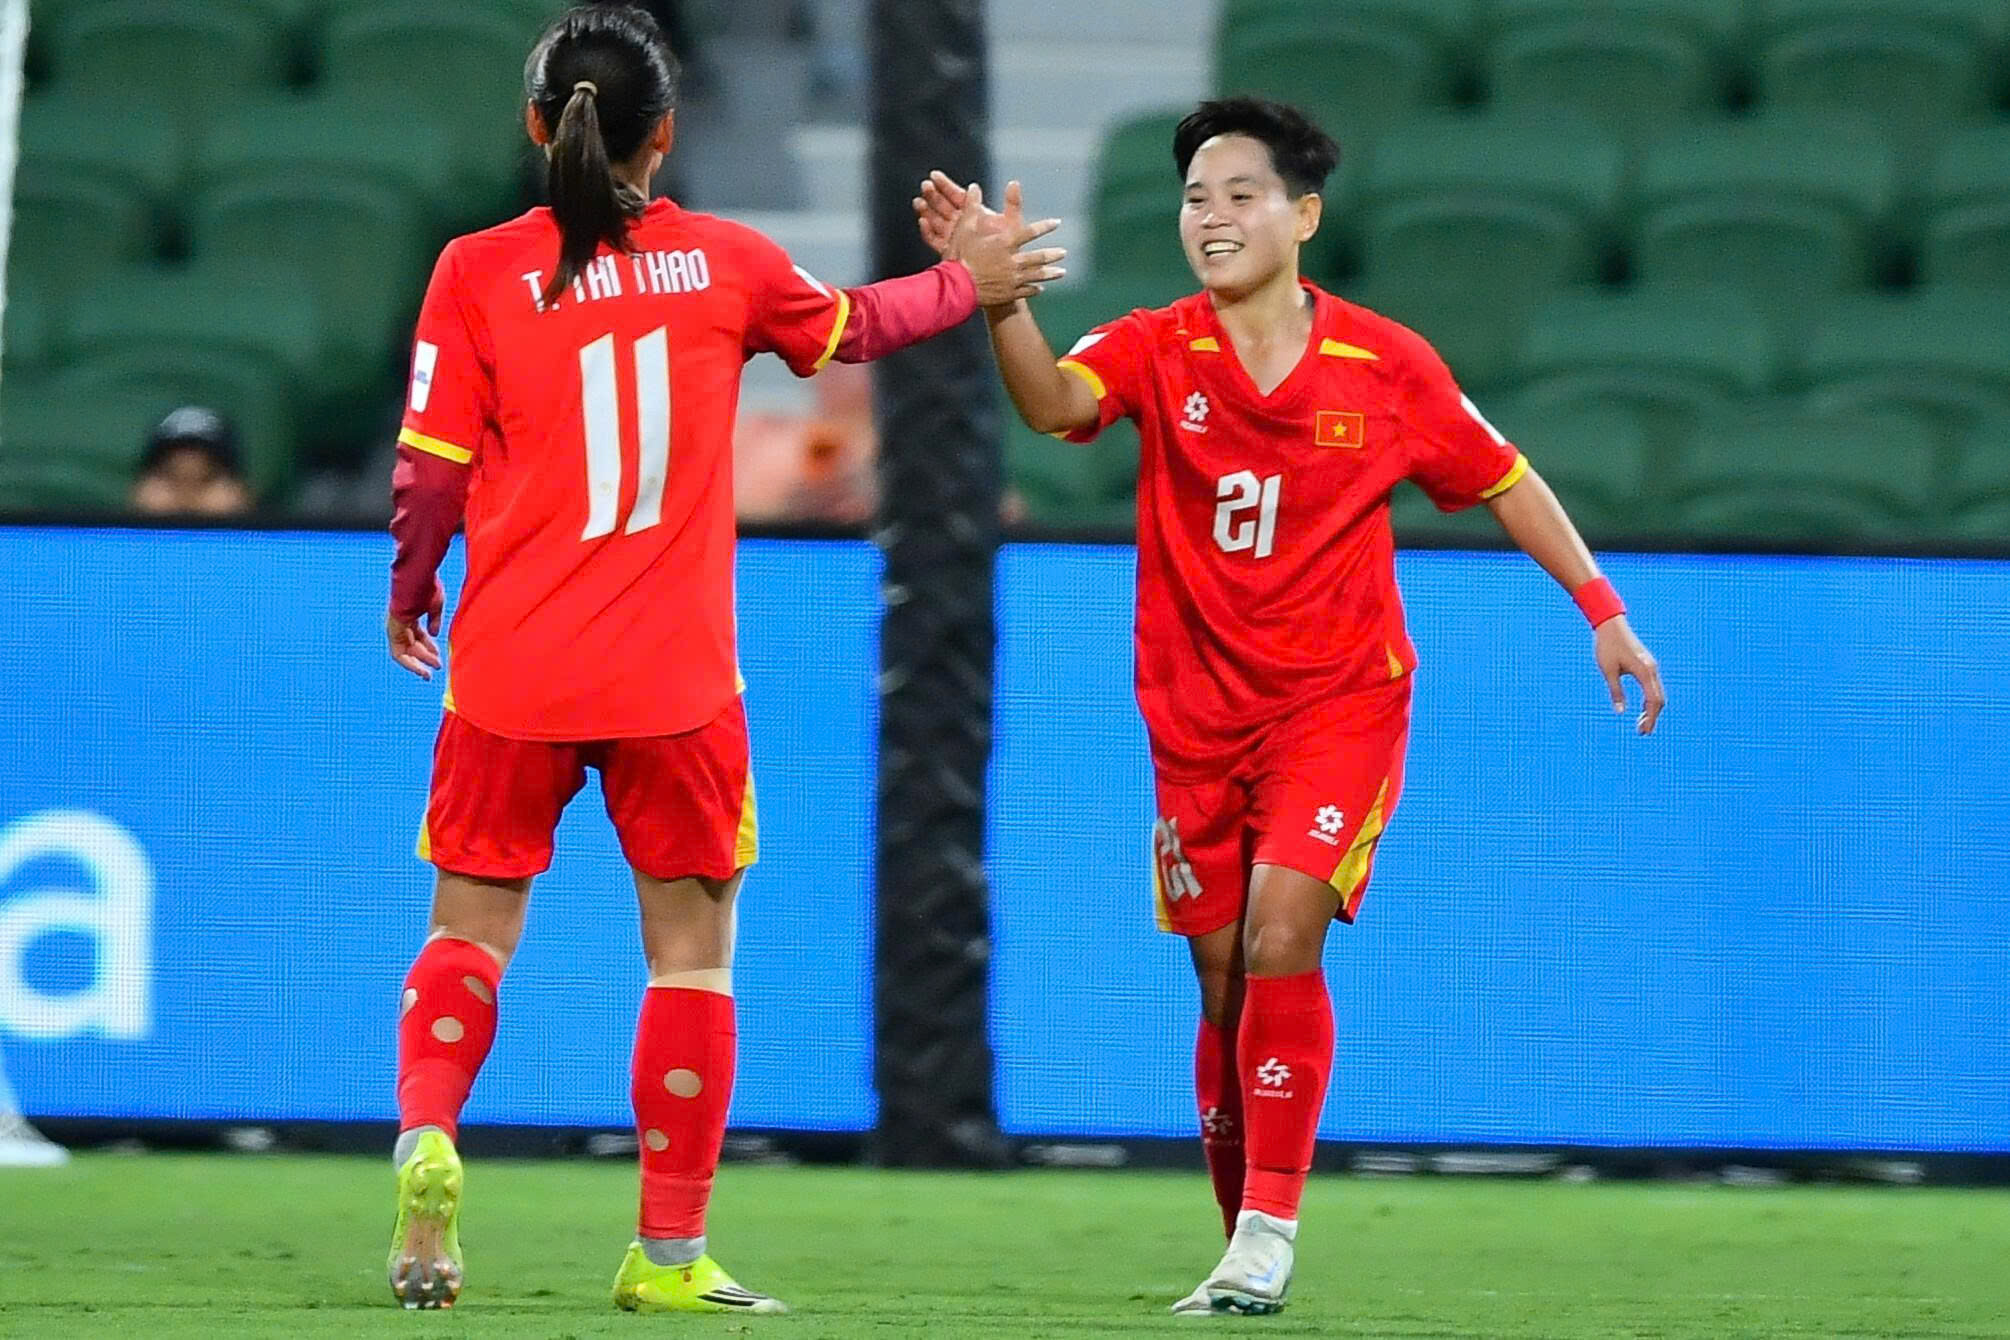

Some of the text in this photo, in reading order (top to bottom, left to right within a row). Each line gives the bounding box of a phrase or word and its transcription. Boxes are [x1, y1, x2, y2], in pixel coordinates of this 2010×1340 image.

[520, 269, 561, 314] T.
[578, 324, 671, 543] 11
[1213, 469, 1282, 560] 21
